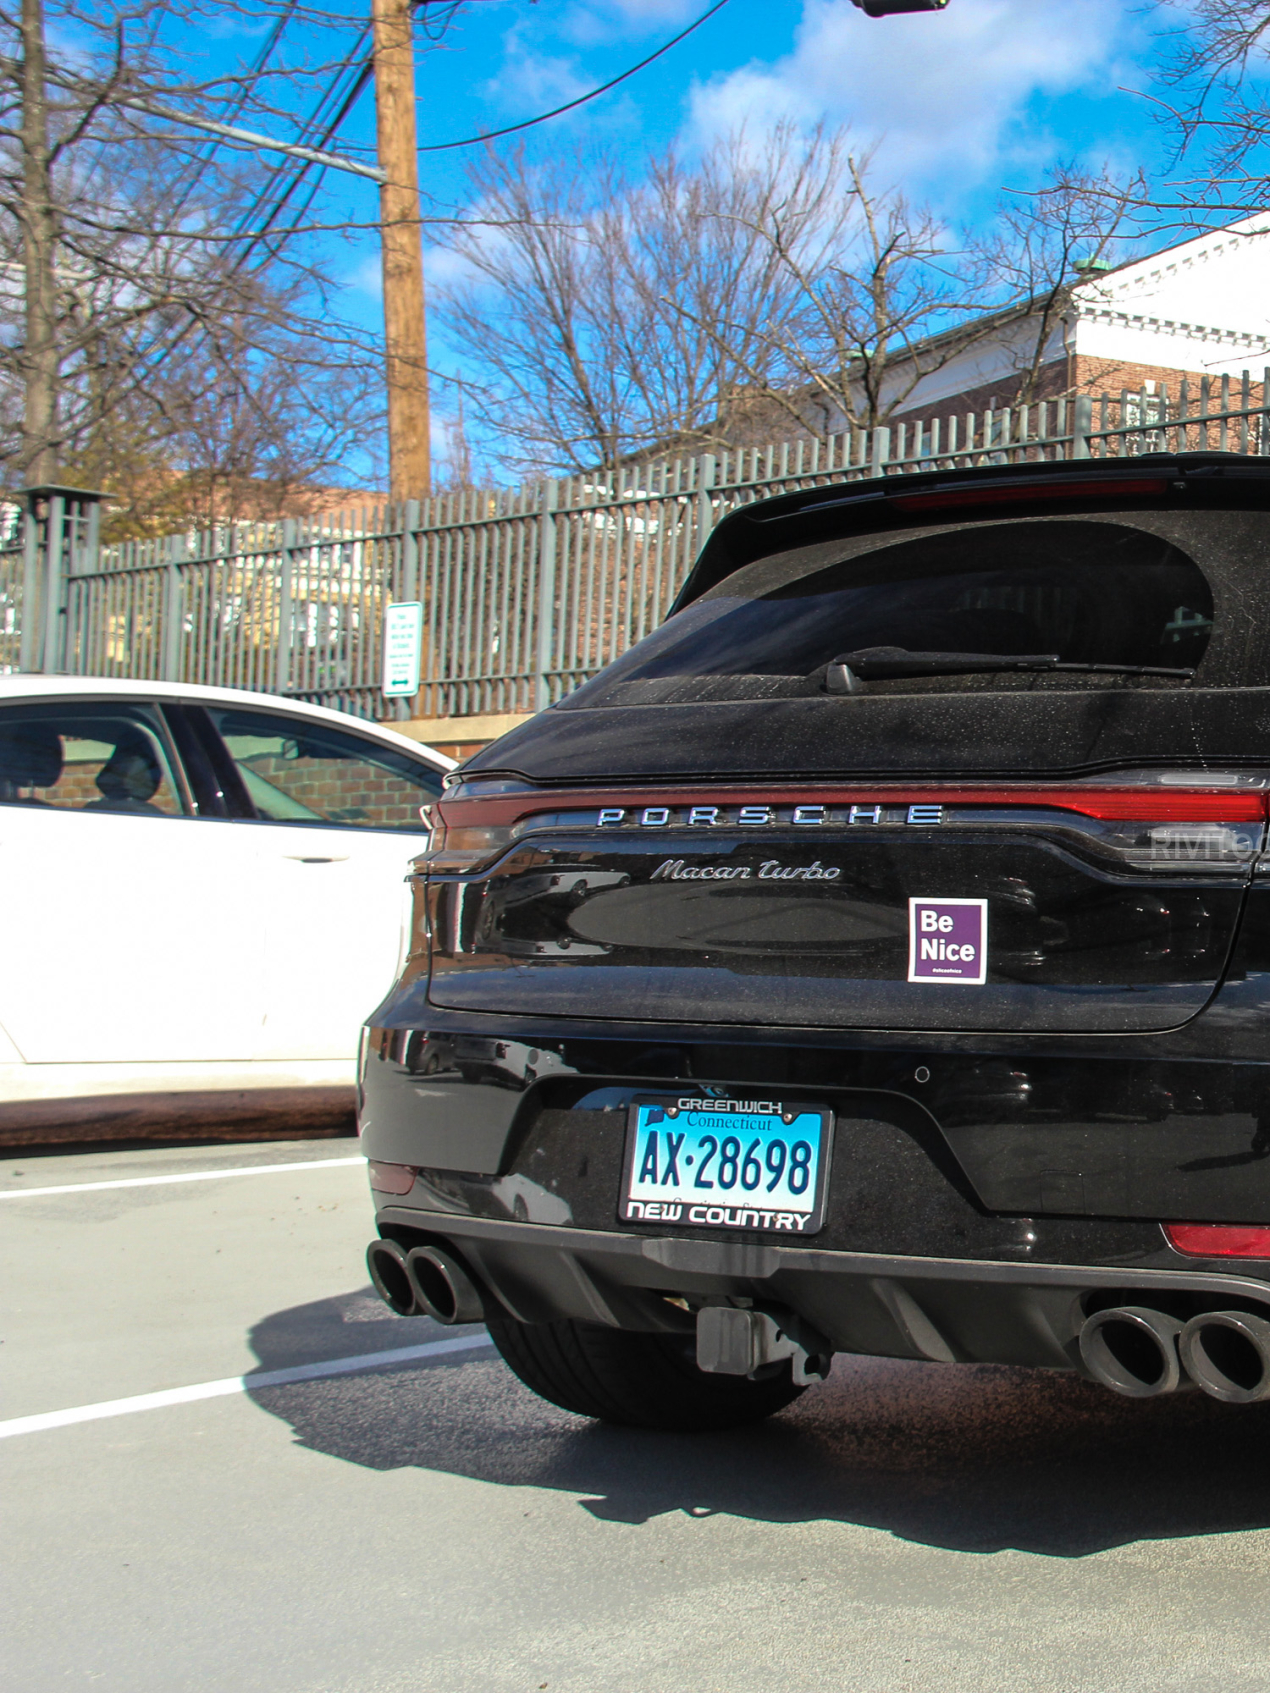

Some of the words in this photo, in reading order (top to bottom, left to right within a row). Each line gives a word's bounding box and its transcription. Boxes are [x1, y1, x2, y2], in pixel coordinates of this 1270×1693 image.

[596, 805, 943, 827] PORSCHE
[650, 859, 750, 880] Macan
[757, 859, 841, 880] Turbo
[920, 910, 954, 933] Be
[920, 938, 976, 962] Nice
[678, 1098, 783, 1114] GREENWICH
[687, 1111, 773, 1131] Connecticut
[626, 1201, 683, 1221] NEW
[688, 1206, 811, 1231] COUNTRY
